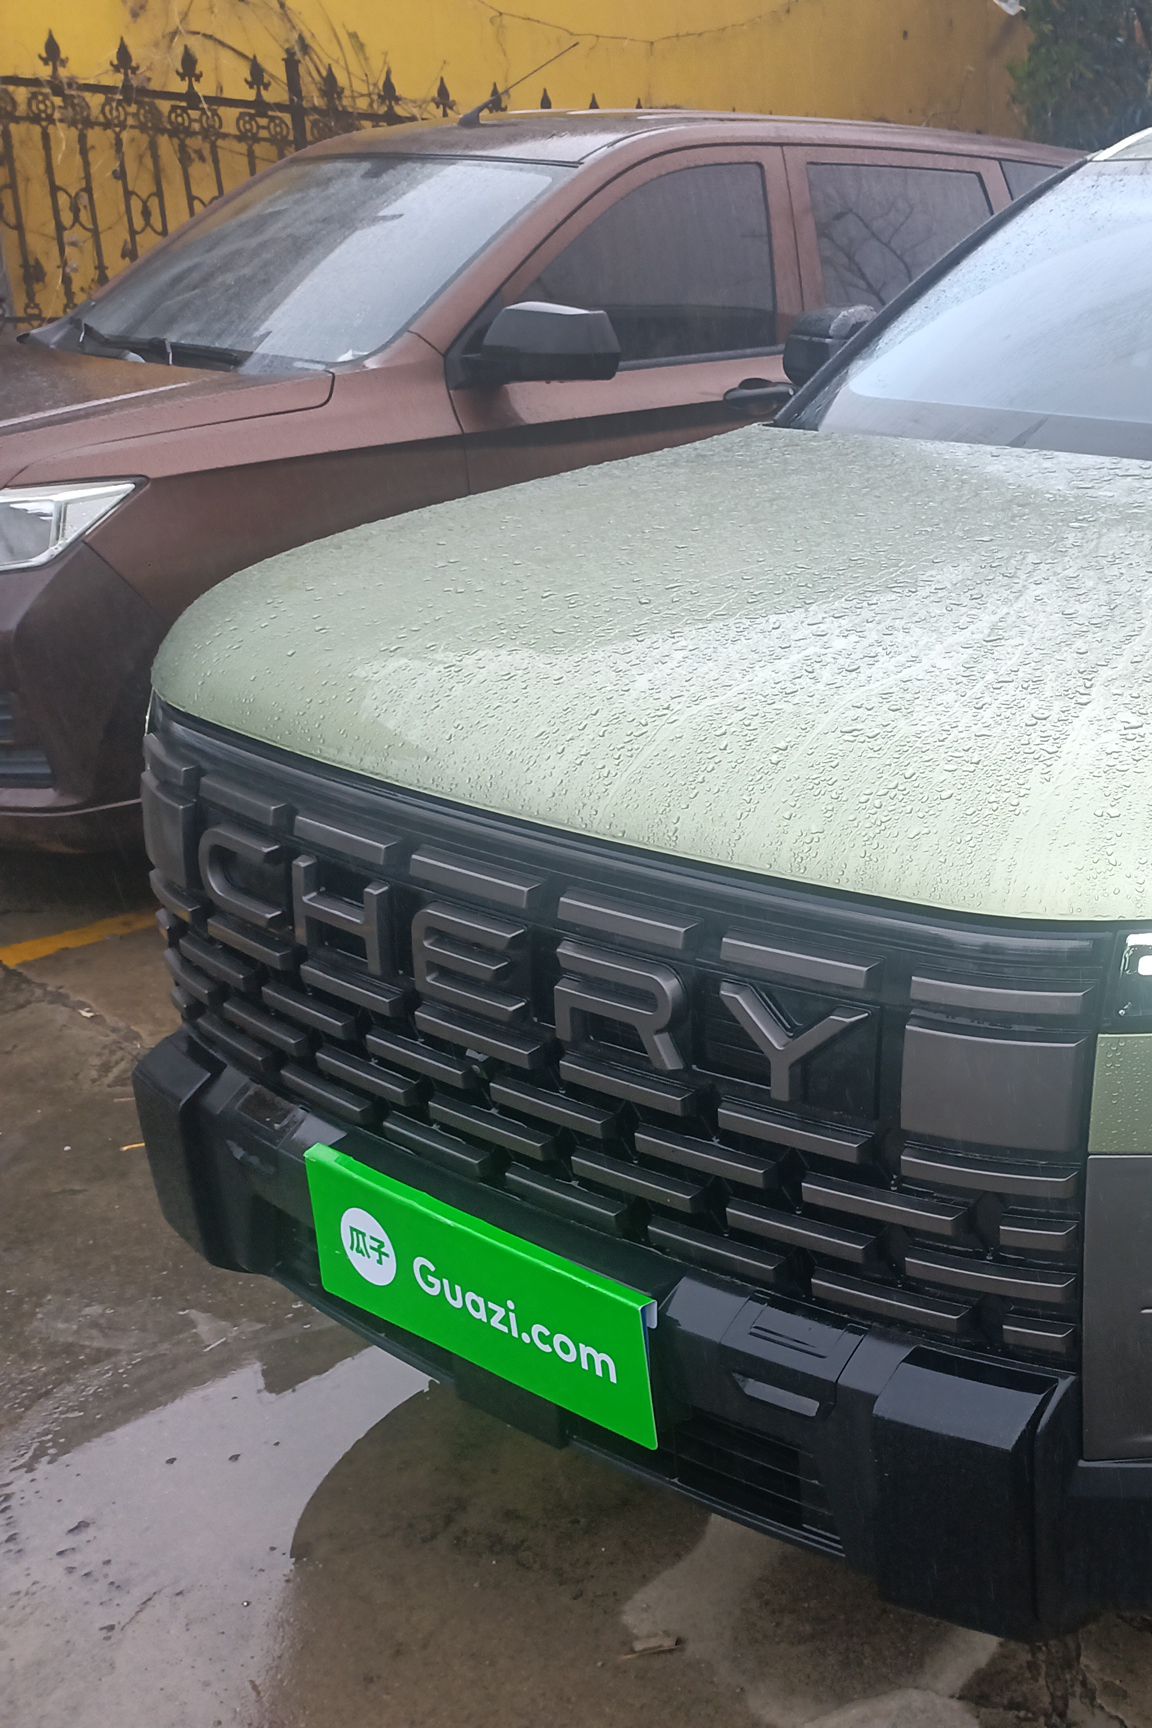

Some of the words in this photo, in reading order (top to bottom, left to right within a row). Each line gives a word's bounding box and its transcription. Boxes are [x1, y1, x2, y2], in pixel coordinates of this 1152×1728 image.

[200, 822, 872, 1101] CHERY
[348, 1225, 390, 1266] 瓜子
[412, 1256, 618, 1384] Guazi.com
